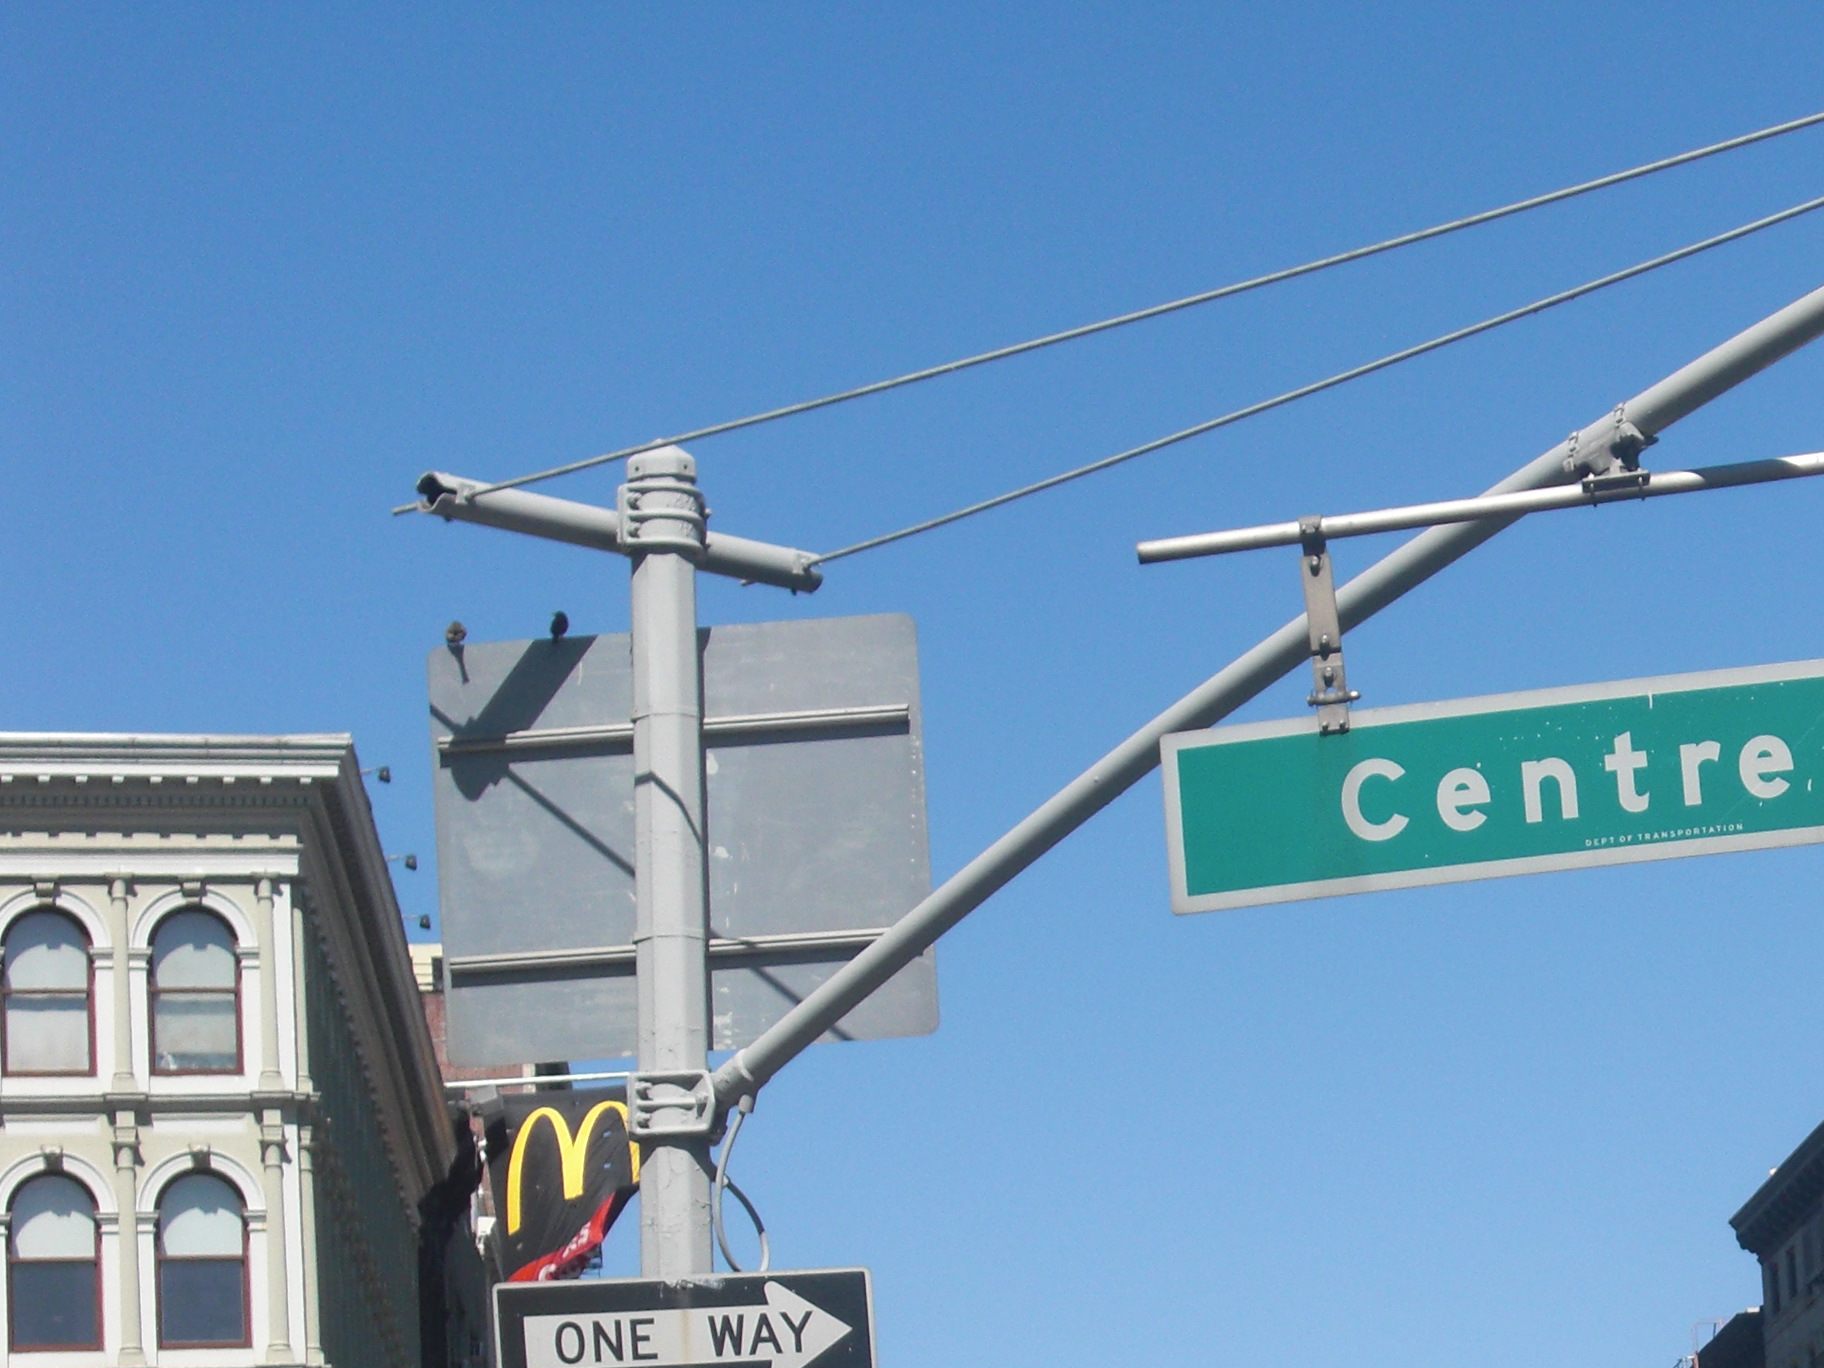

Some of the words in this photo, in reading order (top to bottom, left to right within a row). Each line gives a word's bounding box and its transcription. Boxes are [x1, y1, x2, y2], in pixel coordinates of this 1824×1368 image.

[1341, 731, 1794, 842] Centre
[1585, 836, 1615, 847] DEPT
[1619, 835, 1633, 843] OF
[1638, 823, 1744, 840] TRANSPORTATION
[554, 1317, 659, 1365] ONE
[708, 1310, 813, 1358] WAY
